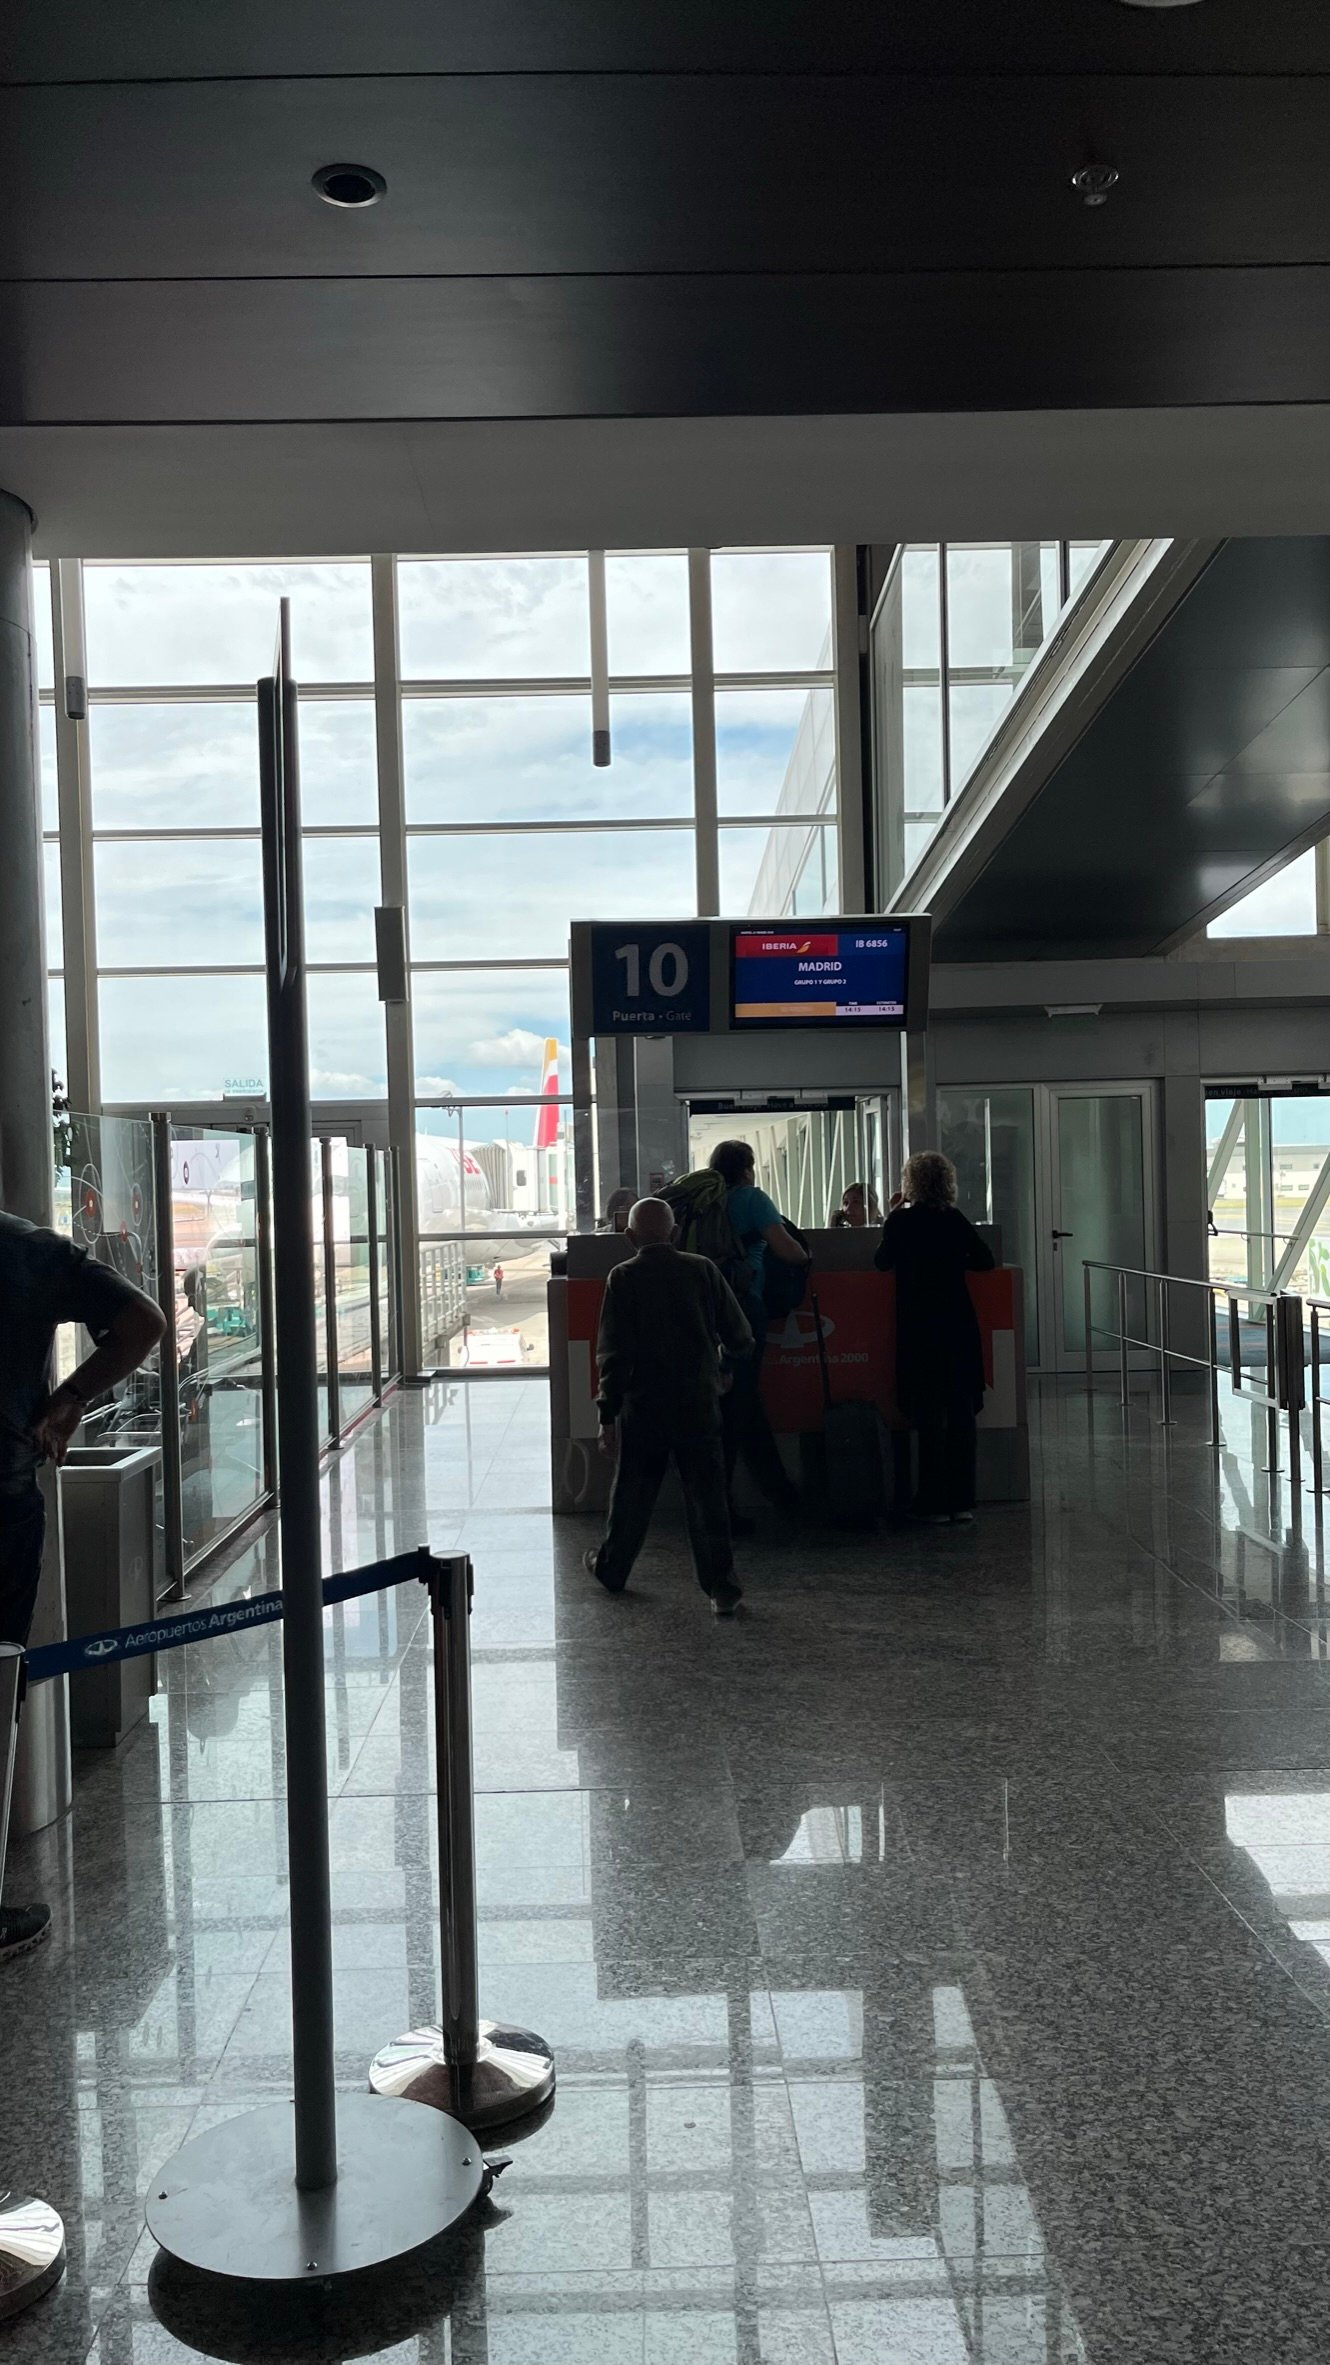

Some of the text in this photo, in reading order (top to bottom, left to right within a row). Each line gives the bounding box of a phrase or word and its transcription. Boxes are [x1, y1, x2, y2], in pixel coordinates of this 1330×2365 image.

[762, 942, 797, 950] IBERIA
[855, 939, 888, 948] IB 6856
[614, 942, 689, 997] 10
[798, 961, 842, 972] MADRID
[612, 1010, 692, 1021] Puerta Gate
[224, 1079, 264, 1088] SALIDA
[840, 1352, 869, 1364] 2000
[124, 1599, 284, 1648] Aeropuertos Argentina
